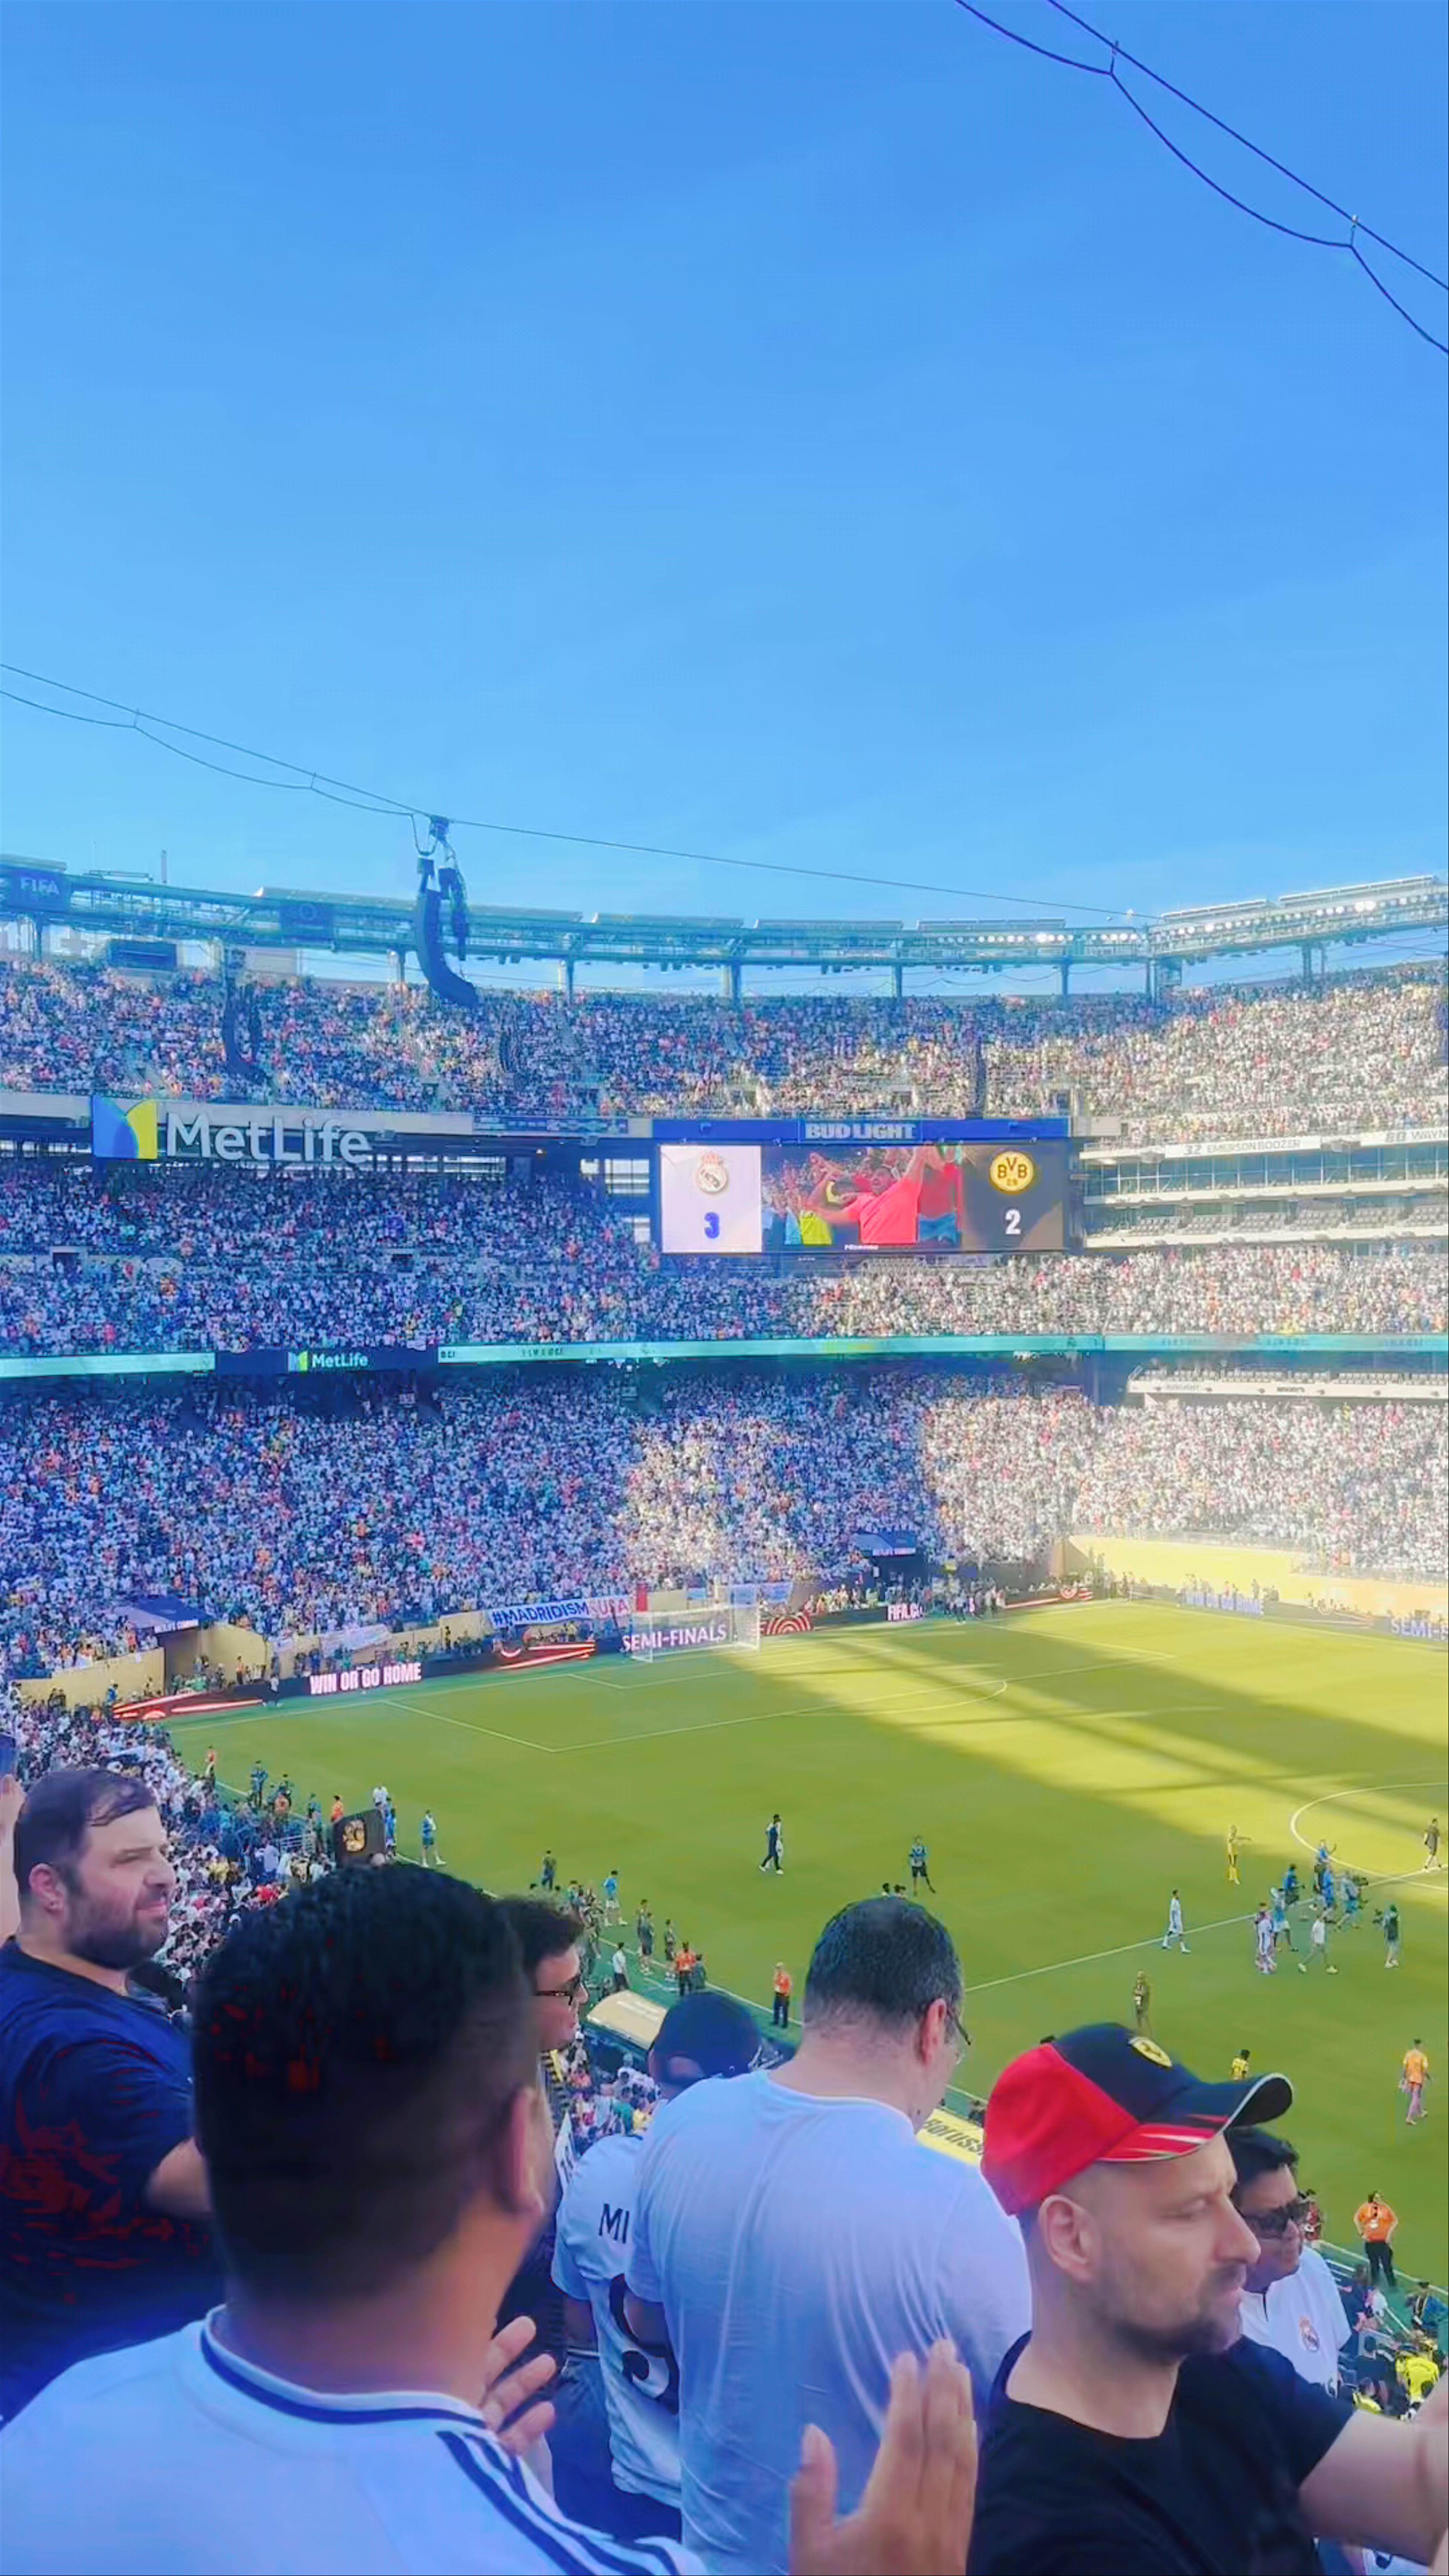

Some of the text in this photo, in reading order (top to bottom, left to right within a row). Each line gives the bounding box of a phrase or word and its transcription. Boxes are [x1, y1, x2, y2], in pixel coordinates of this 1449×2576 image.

[20, 878, 59, 895] FIFA
[167, 1112, 372, 1163] MetLife
[805, 1123, 916, 1139] BUD LIGHT
[1258, 1140, 1300, 1150] BOOZER
[997, 1157, 1028, 1178] BVB
[705, 1212, 719, 1239] 3
[1005, 1209, 1021, 1234] 2
[312, 1352, 369, 1368] MetLife
[619, 1624, 727, 1653] SEMI-FINALS
[310, 1662, 421, 1695] WIN OR GO HOME
